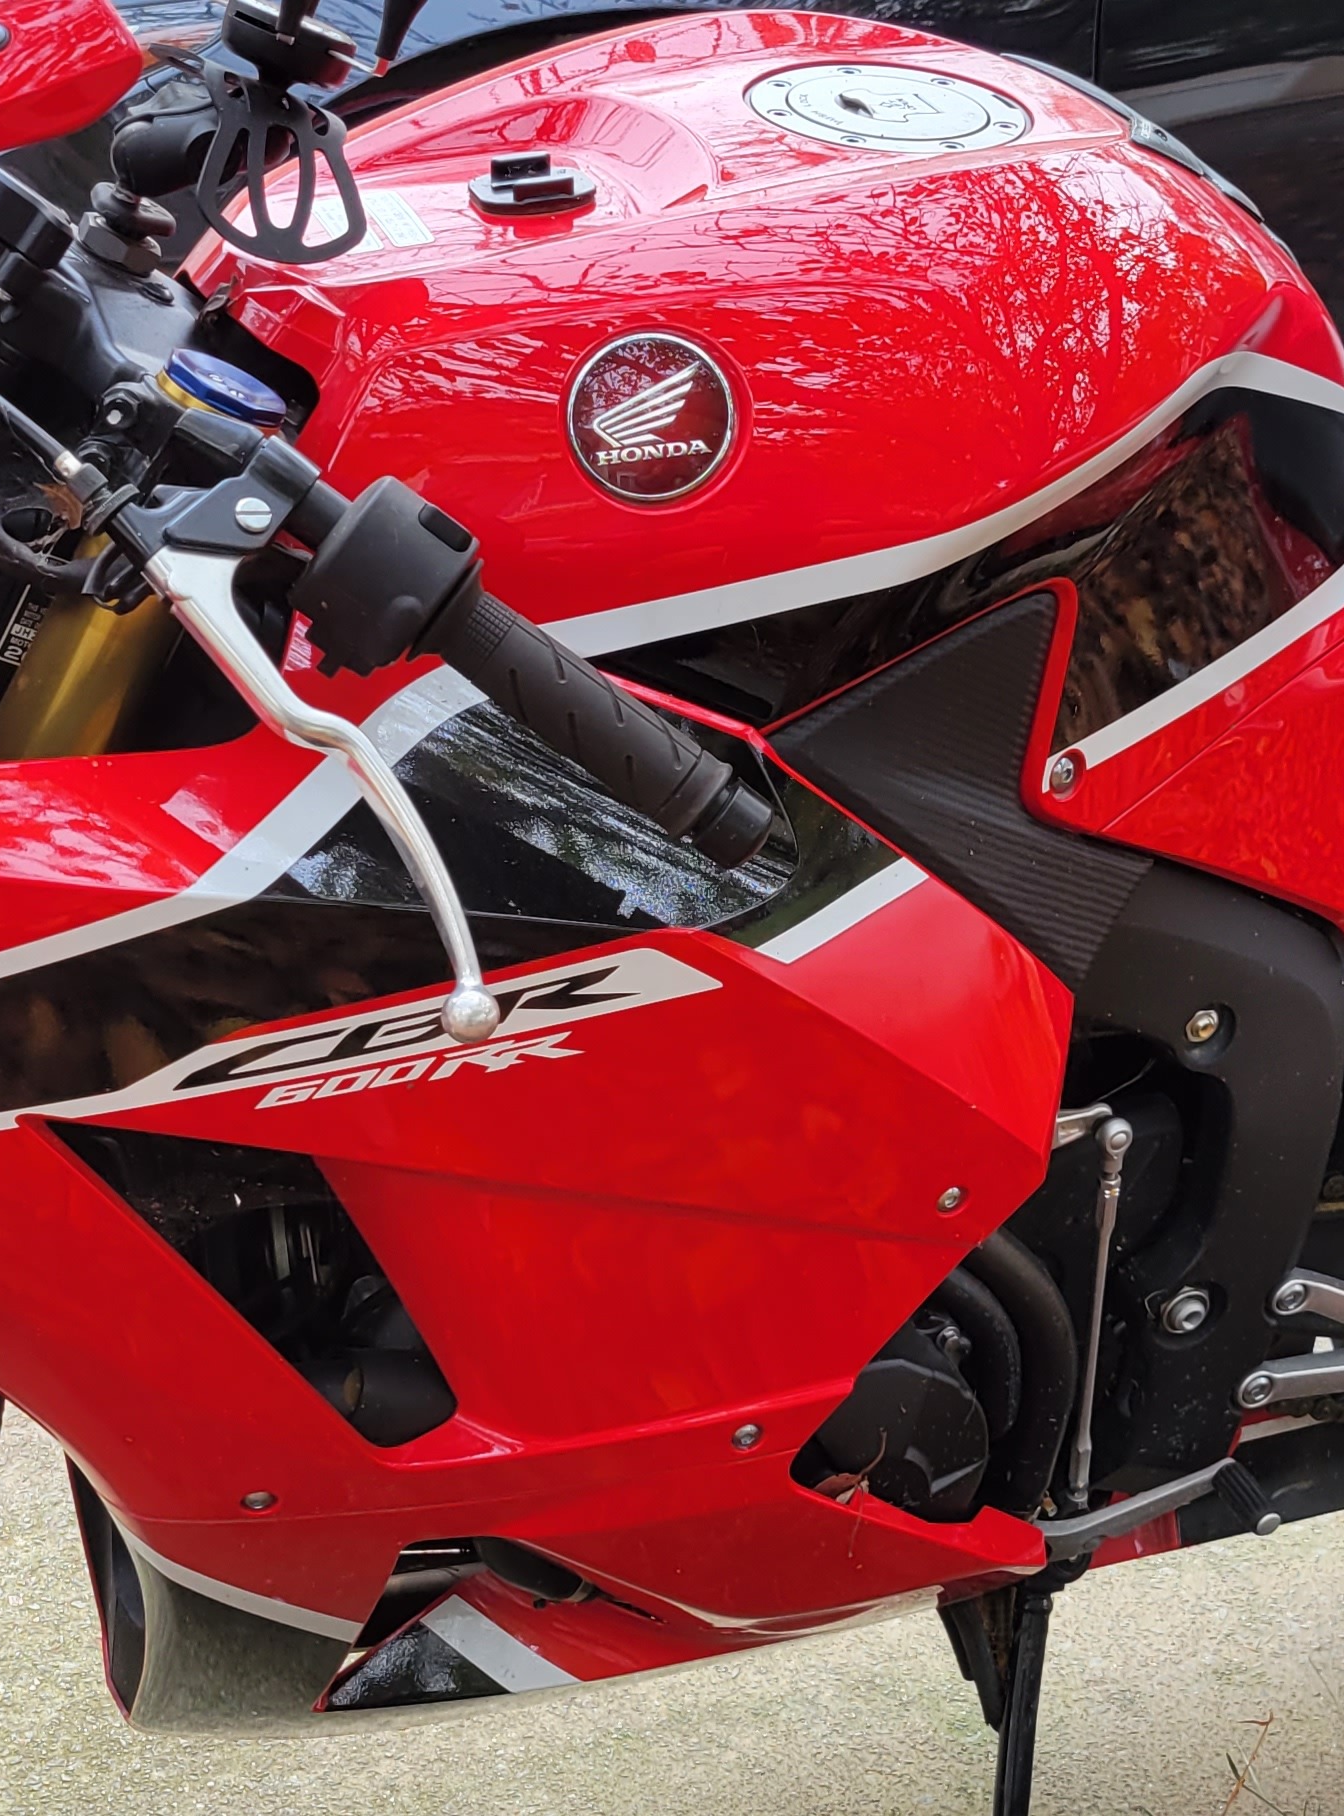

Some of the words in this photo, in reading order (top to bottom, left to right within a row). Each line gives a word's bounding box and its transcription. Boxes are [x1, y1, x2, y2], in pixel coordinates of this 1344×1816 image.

[596, 439, 712, 466] HONDA
[173, 966, 641, 1091] CBR
[255, 1031, 586, 1109] 600RR
